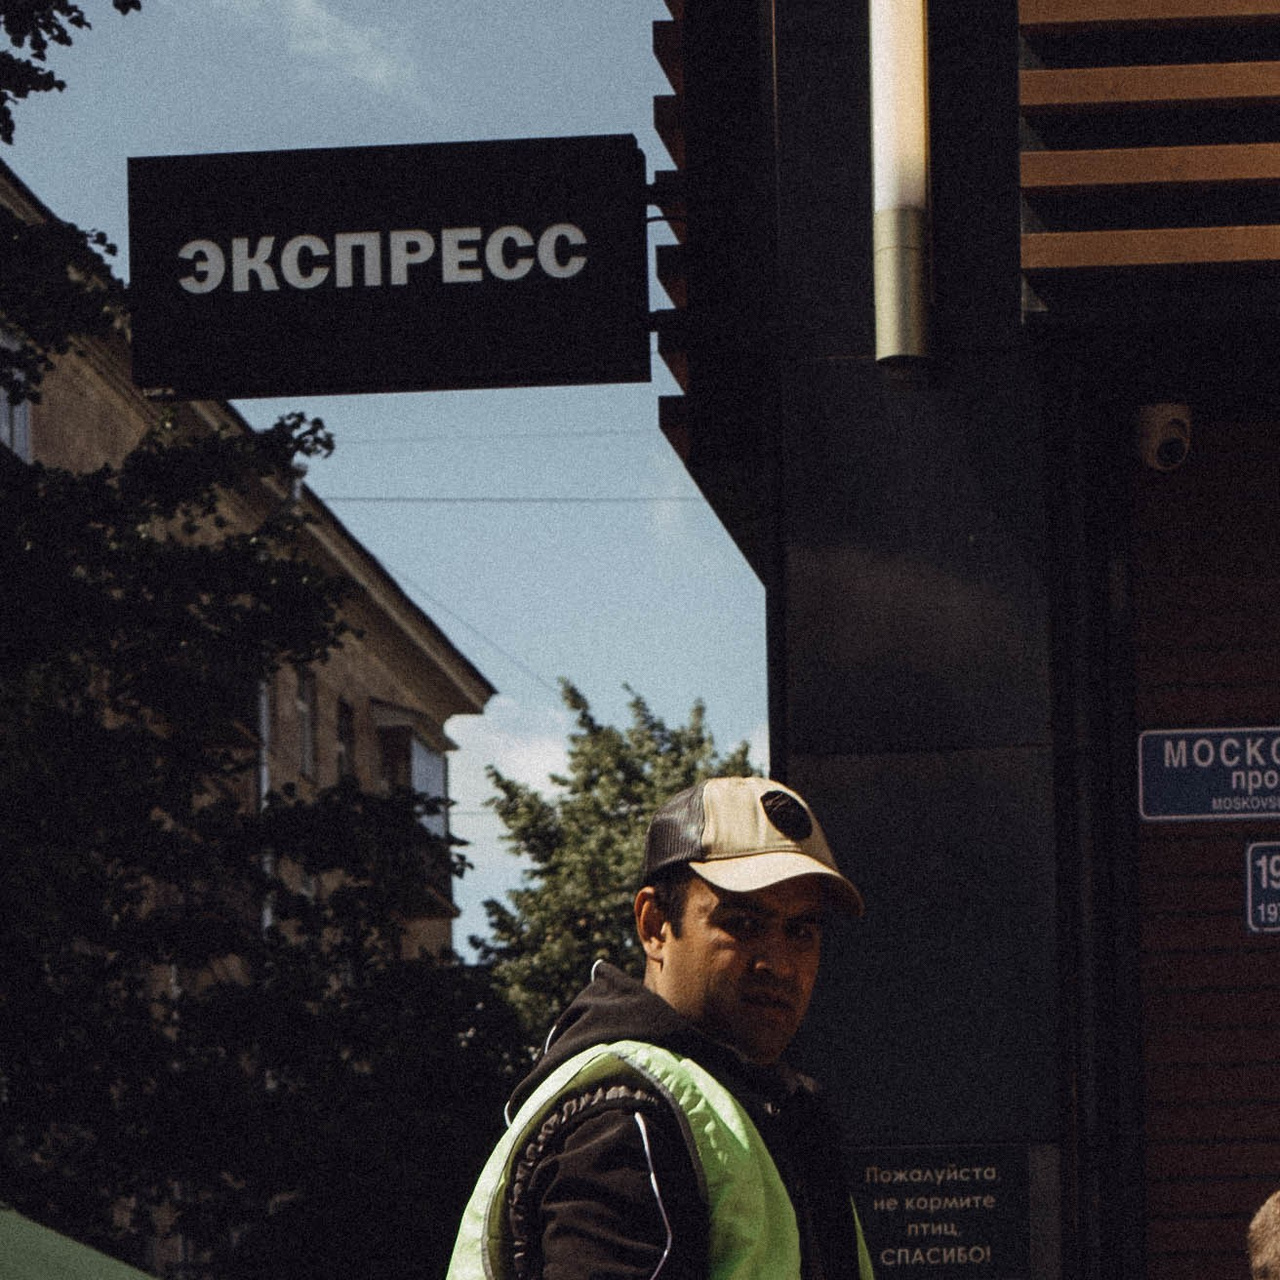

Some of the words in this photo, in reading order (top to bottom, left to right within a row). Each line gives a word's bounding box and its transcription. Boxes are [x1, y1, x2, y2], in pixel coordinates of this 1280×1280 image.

[177, 223, 588, 294] ЭКСПРЕСС
[873, 1198, 898, 1211] не
[905, 1195, 996, 1213] кормите
[880, 1246, 992, 1266] СПАСИБО!
